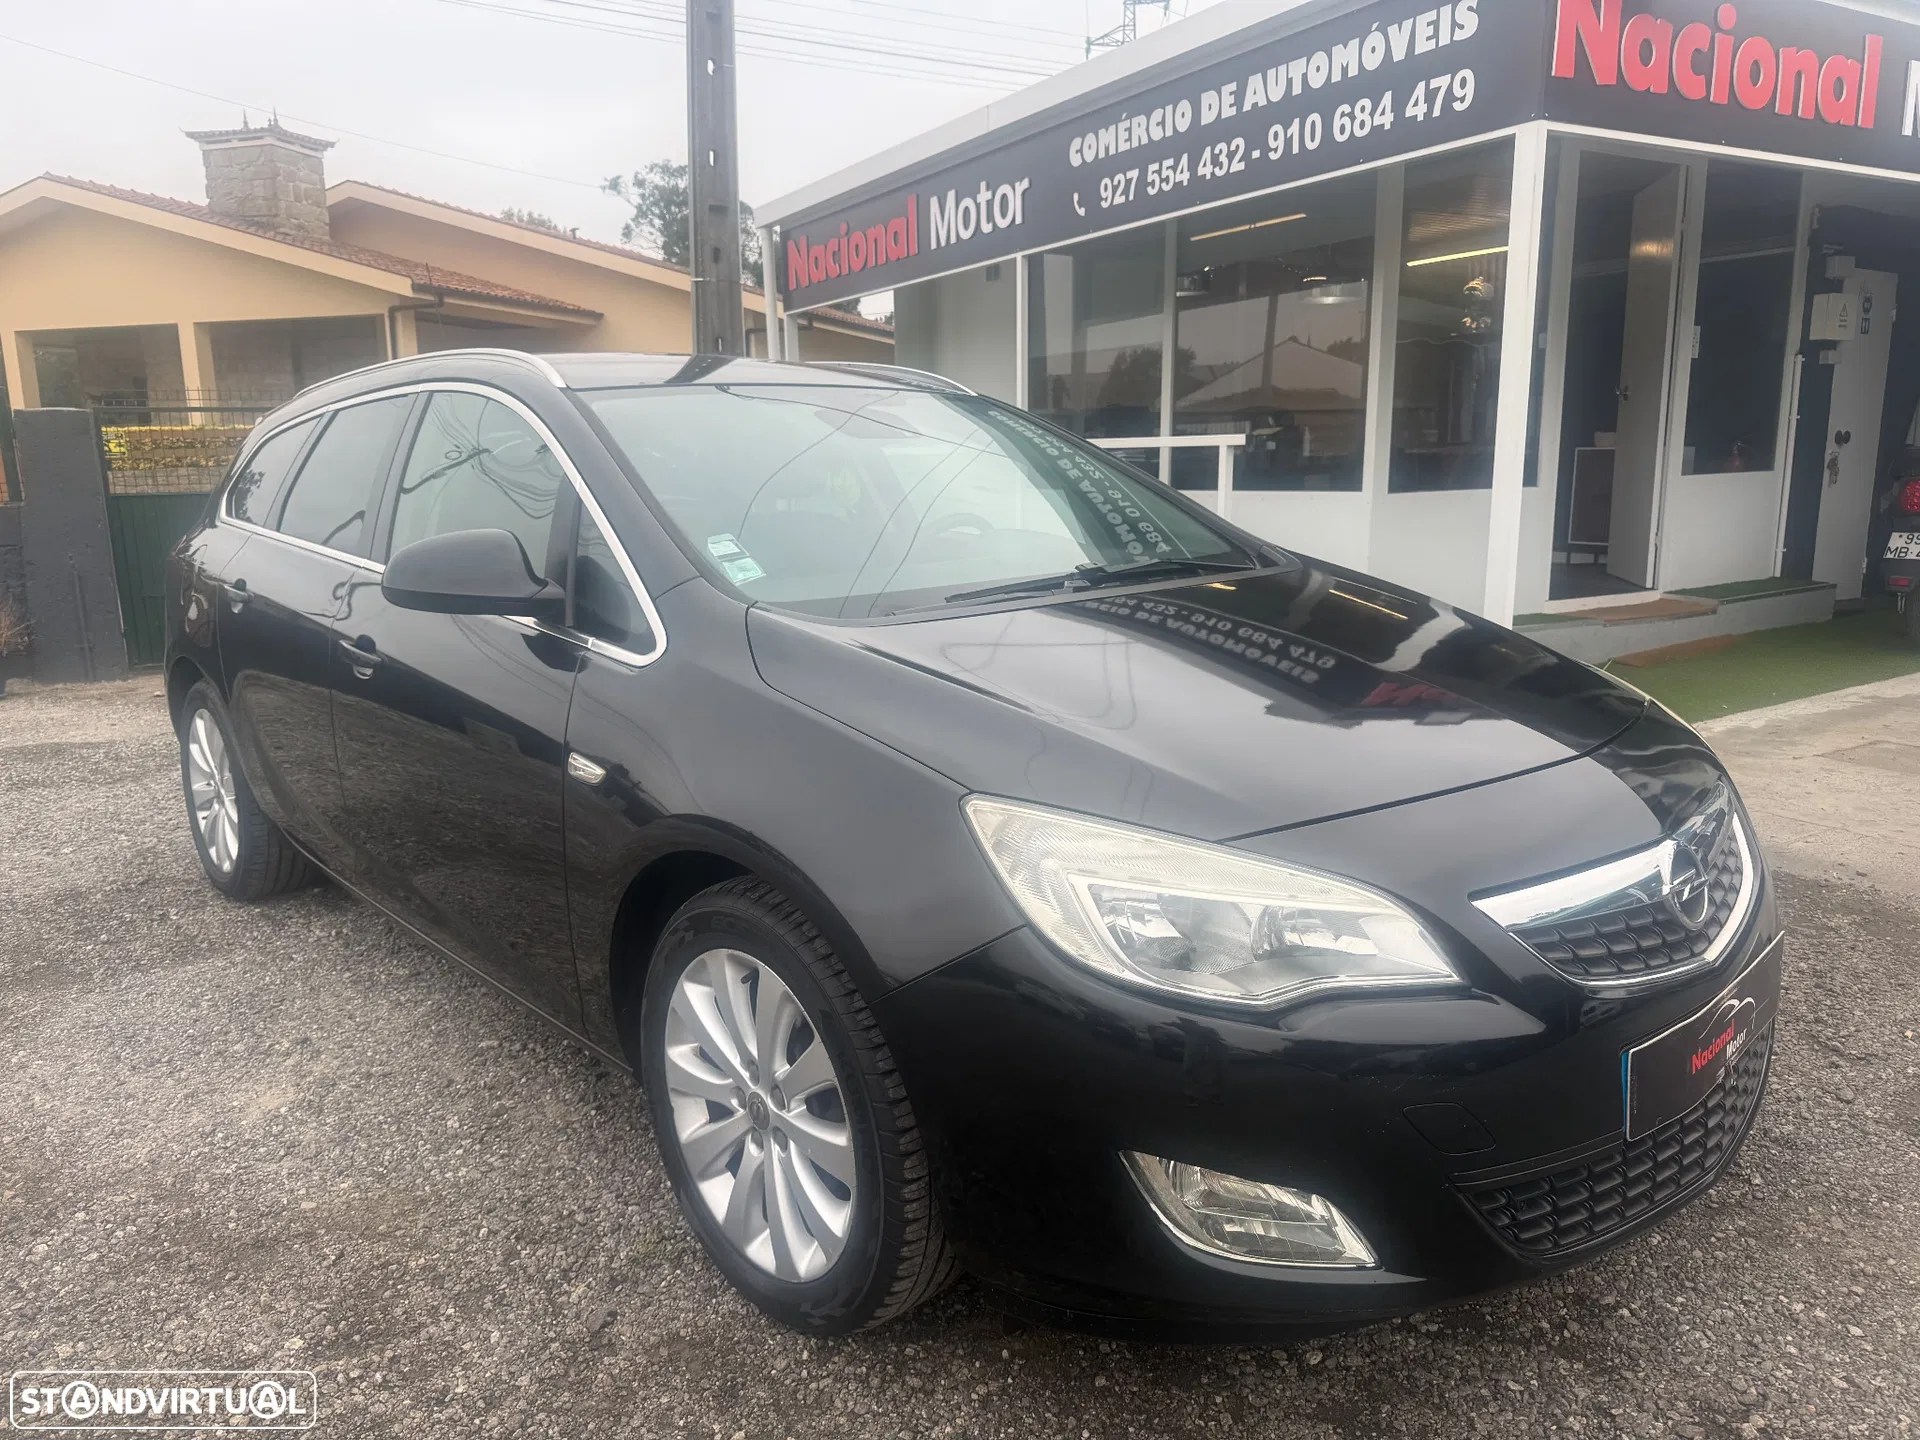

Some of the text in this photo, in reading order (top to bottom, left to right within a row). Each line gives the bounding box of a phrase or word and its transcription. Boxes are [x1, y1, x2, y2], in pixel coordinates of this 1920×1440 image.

[1068, 0, 1480, 167] COMÉRCIO DE AUTOMÓVEIS
[1551, 0, 1884, 129] Nacional
[1099, 68, 1476, 209] 927 554 432 - 910 684 479
[787, 177, 1031, 291] Nacional Motor
[1691, 1018, 1735, 1075] Nacional
[1726, 1027, 1748, 1060] Motor
